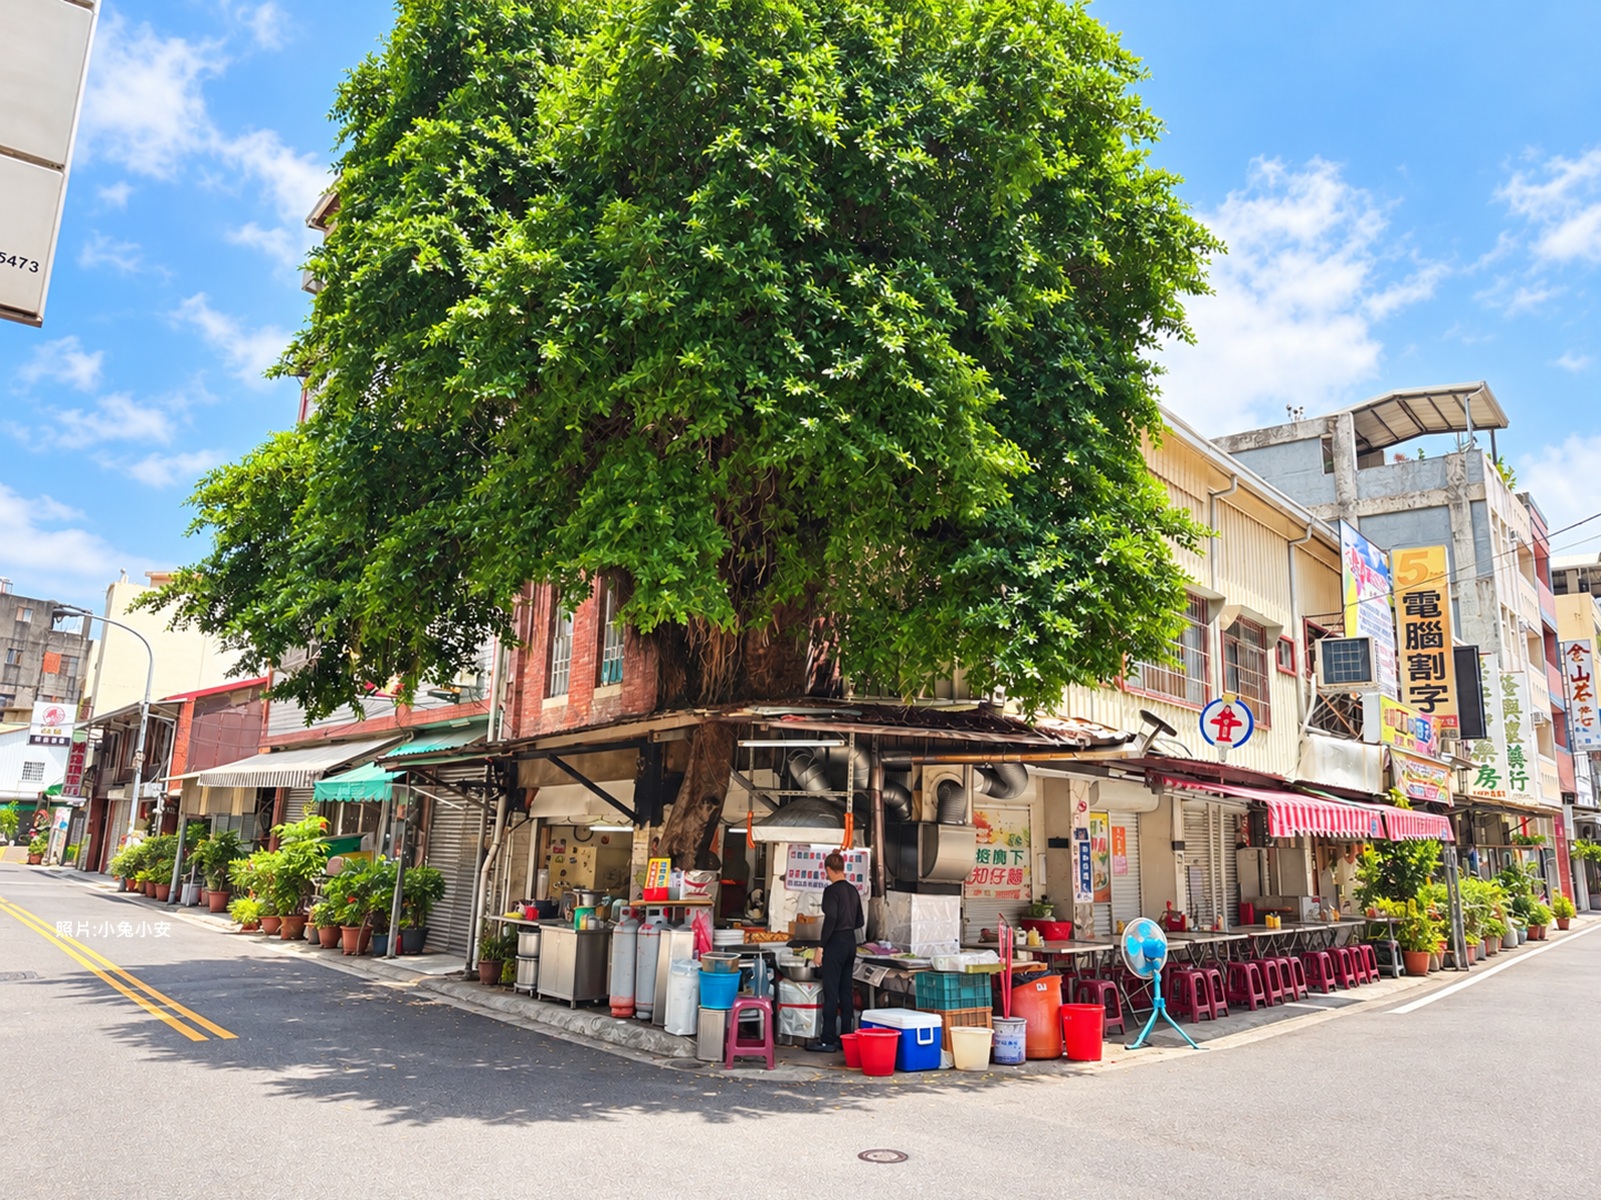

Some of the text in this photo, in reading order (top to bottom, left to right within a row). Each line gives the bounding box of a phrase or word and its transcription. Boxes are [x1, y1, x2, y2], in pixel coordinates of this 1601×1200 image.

[0, 251, 39, 273] 5473
[1397, 551, 1428, 586] 5
[1403, 589, 1449, 714] 電腦割字
